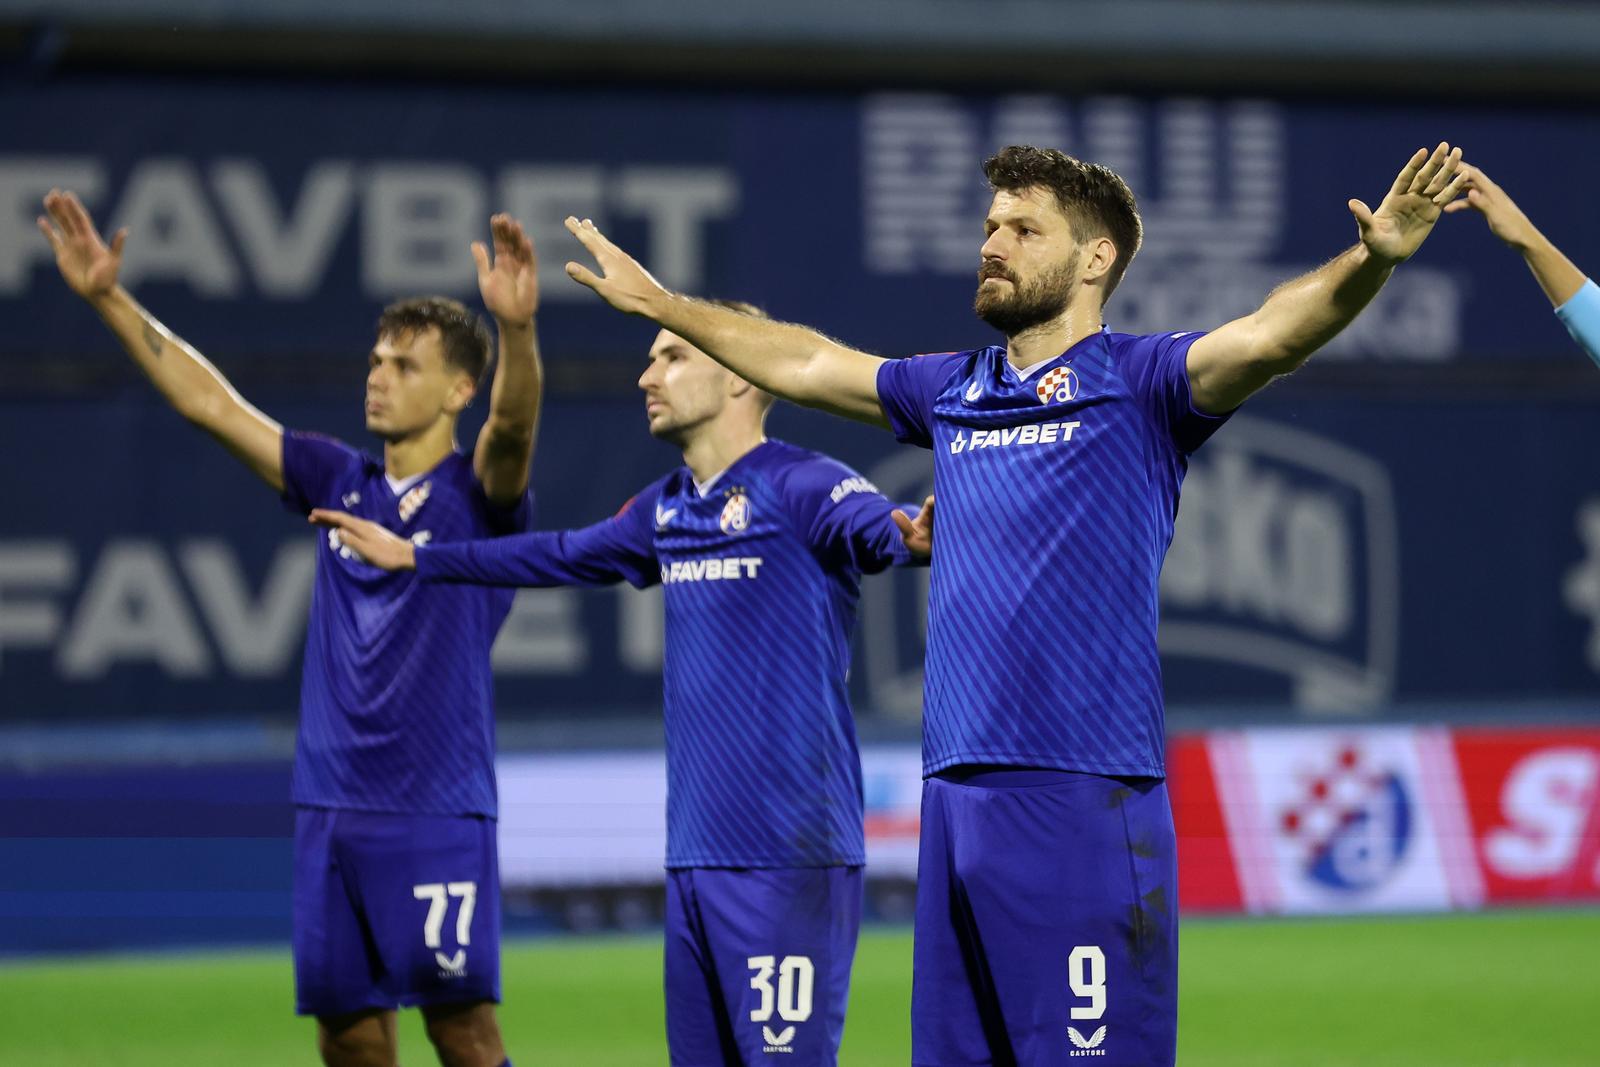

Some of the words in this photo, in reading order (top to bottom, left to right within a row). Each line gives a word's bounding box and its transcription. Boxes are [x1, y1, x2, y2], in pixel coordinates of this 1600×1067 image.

[0, 158, 738, 297] FAVBET
[968, 421, 1081, 451] FAVBET
[668, 557, 763, 583] FAVBET
[413, 881, 477, 949] 77
[747, 955, 815, 1022] 30
[1068, 946, 1107, 1020] 9
[1069, 1049, 1106, 1057] CASTORE
